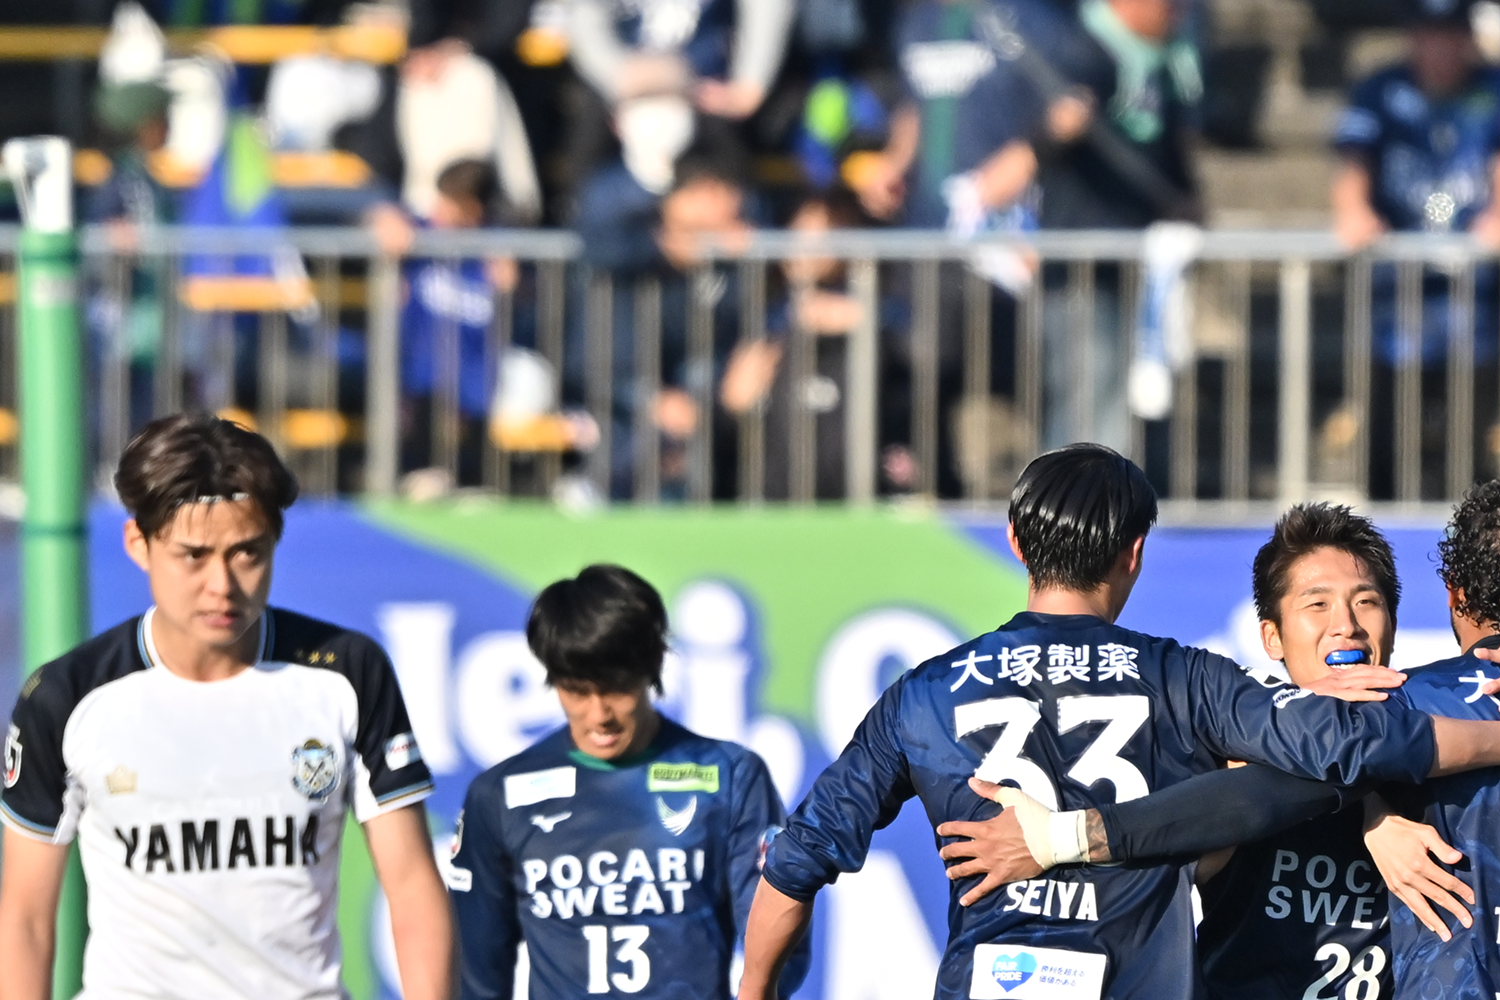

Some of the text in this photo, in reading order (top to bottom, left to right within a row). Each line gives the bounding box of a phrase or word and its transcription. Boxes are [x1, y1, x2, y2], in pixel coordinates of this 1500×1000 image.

[950, 643, 1140, 693] 大塚製薬
[954, 695, 1150, 813] 33
[114, 814, 321, 873] YAMAHA
[523, 847, 705, 894] POCARI
[1271, 849, 1388, 895] POC
[530, 881, 692, 919] SWEAT
[1003, 878, 1099, 922] SEIYA
[1265, 885, 1388, 930] SWE
[582, 924, 651, 994] 13
[994, 971, 1023, 982] PRIDE
[995, 961, 1018, 971] FAIR
